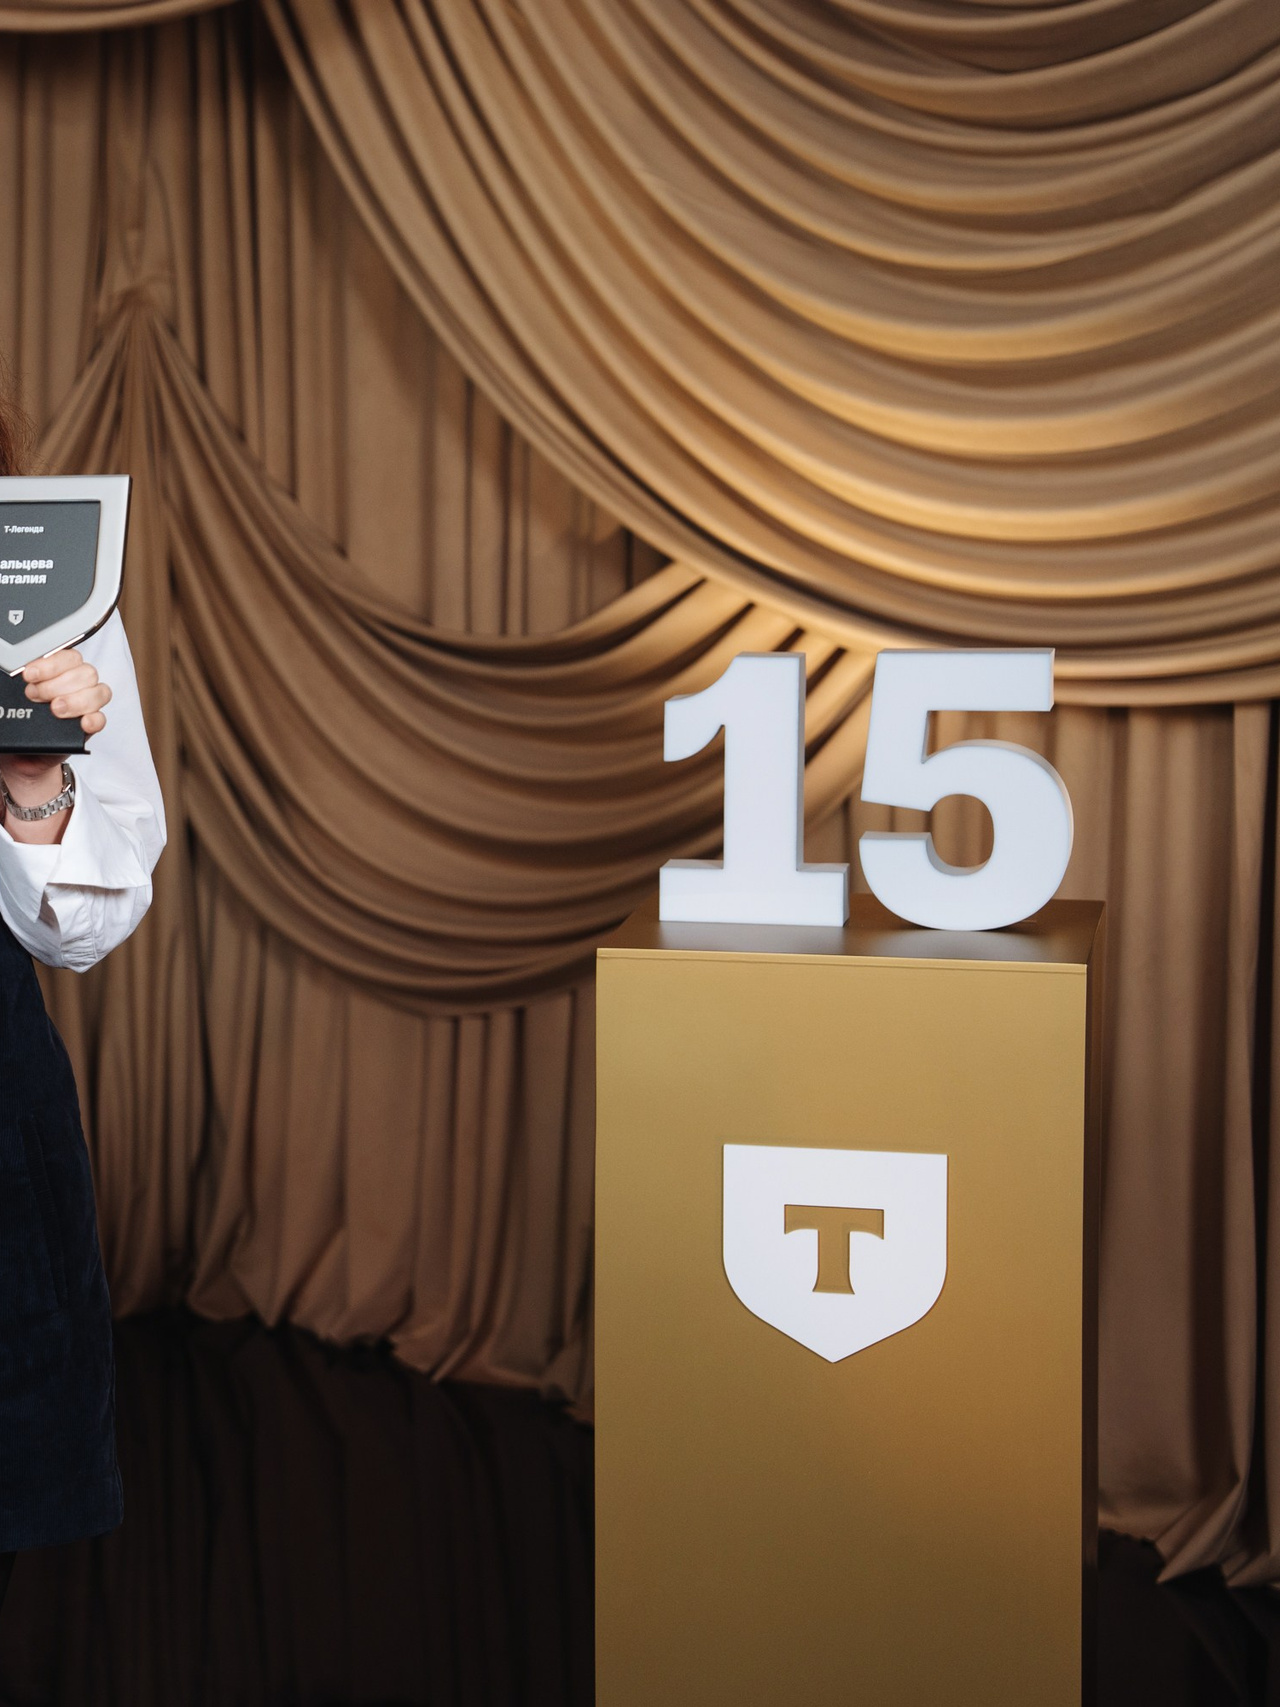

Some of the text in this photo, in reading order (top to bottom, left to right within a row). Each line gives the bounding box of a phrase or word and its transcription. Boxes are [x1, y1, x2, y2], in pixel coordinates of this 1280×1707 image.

[4, 525, 44, 534] Т-Легенда
[7, 707, 33, 719] лет
[659, 648, 1074, 931] 15
